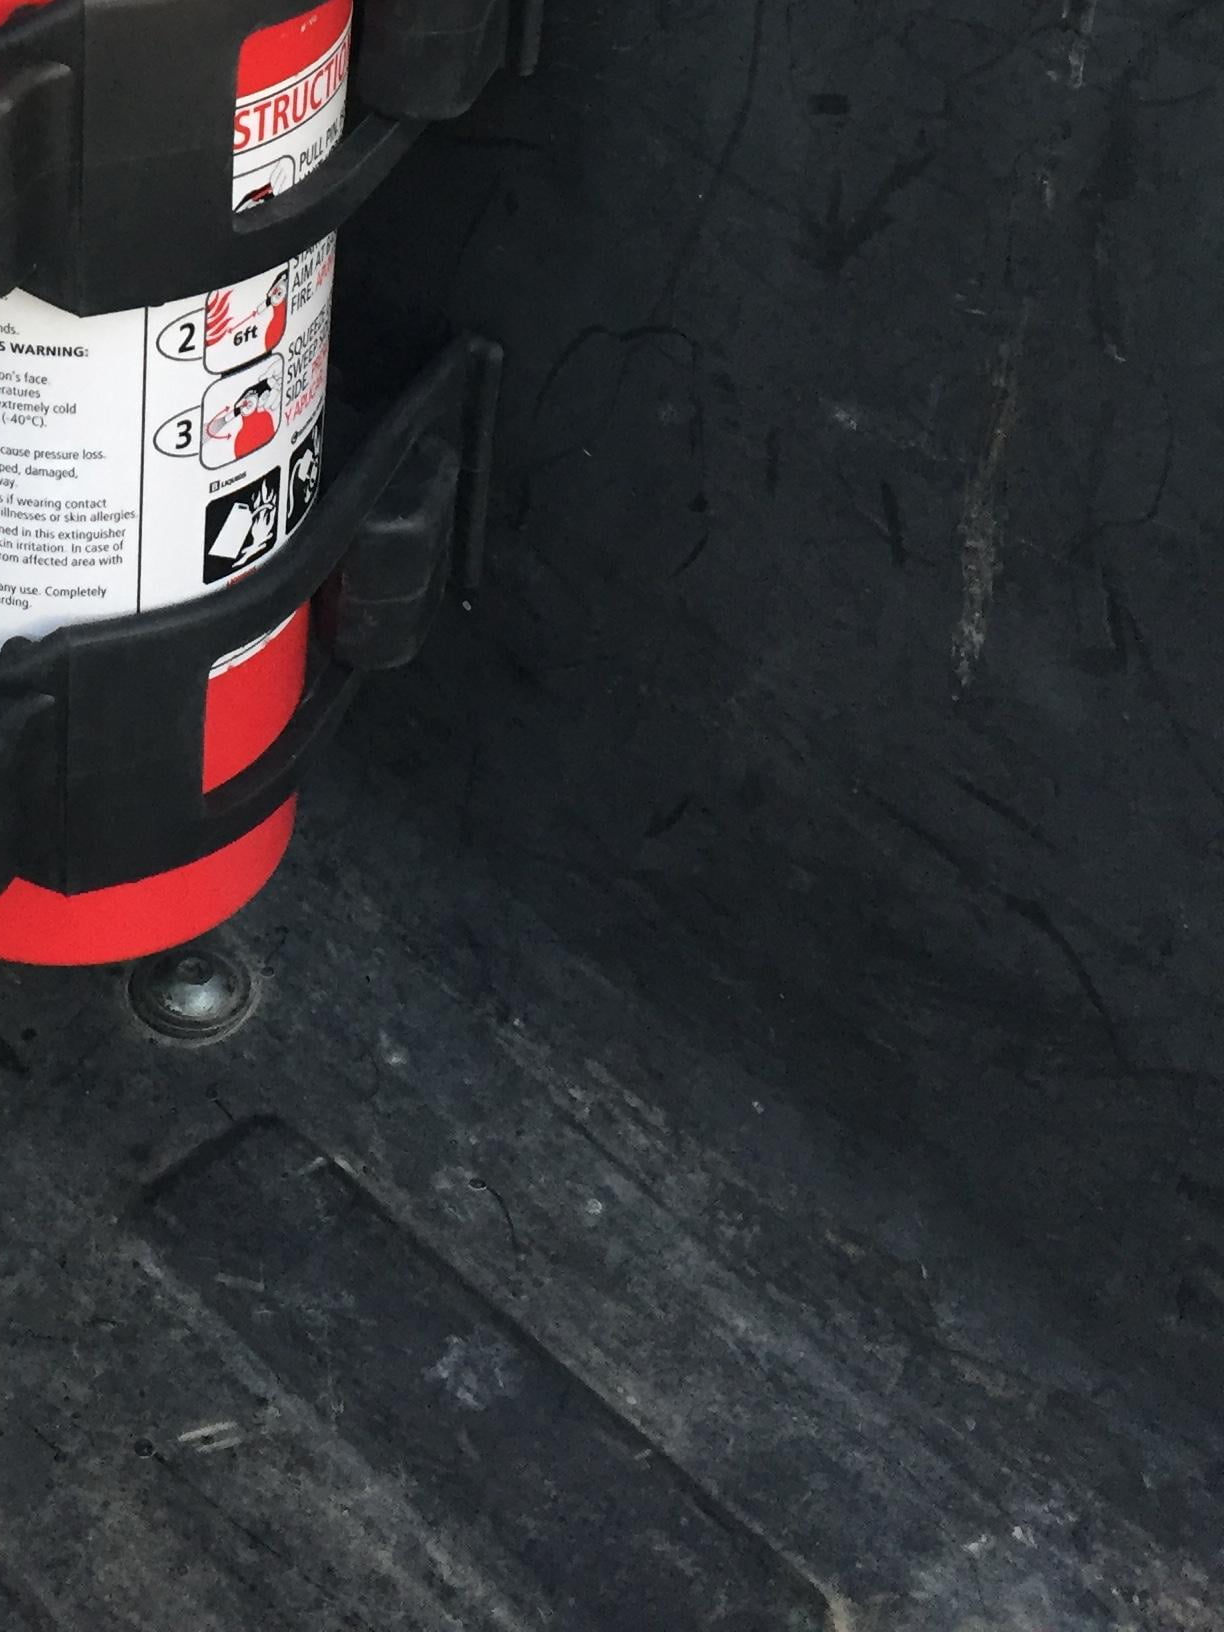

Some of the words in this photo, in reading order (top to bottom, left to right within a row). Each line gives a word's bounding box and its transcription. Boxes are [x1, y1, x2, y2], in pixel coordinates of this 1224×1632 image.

[299, 135, 323, 172] PULL
[291, 258, 314, 292] AIM
[178, 322, 196, 354] 2
[232, 325, 259, 348] 6ft
[10, 342, 89, 358] WARNING:
[53, 402, 77, 415] cold
[175, 419, 192, 450] 3
[0, 446, 30, 457] cause
[33, 449, 79, 461] pressure
[82, 449, 107, 460] loss.
[24, 464, 78, 480] damaged,
[6, 493, 14, 505] if
[17, 497, 62, 511] wearing
[64, 498, 107, 509] contact
[0, 507, 47, 522] illnesses
[49, 511, 60, 522] or
[63, 511, 87, 523] skin
[21, 525, 32, 537] in
[35, 527, 55, 539] this
[58, 528, 126, 542] extinguisher
[71, 543, 82, 554] In
[84, 543, 110, 553] case
[112, 539, 124, 551] of
[22, 554, 68, 567] affected
[71, 557, 96, 567] area
[98, 554, 123, 566] with
[44, 586, 108, 599] Completely
